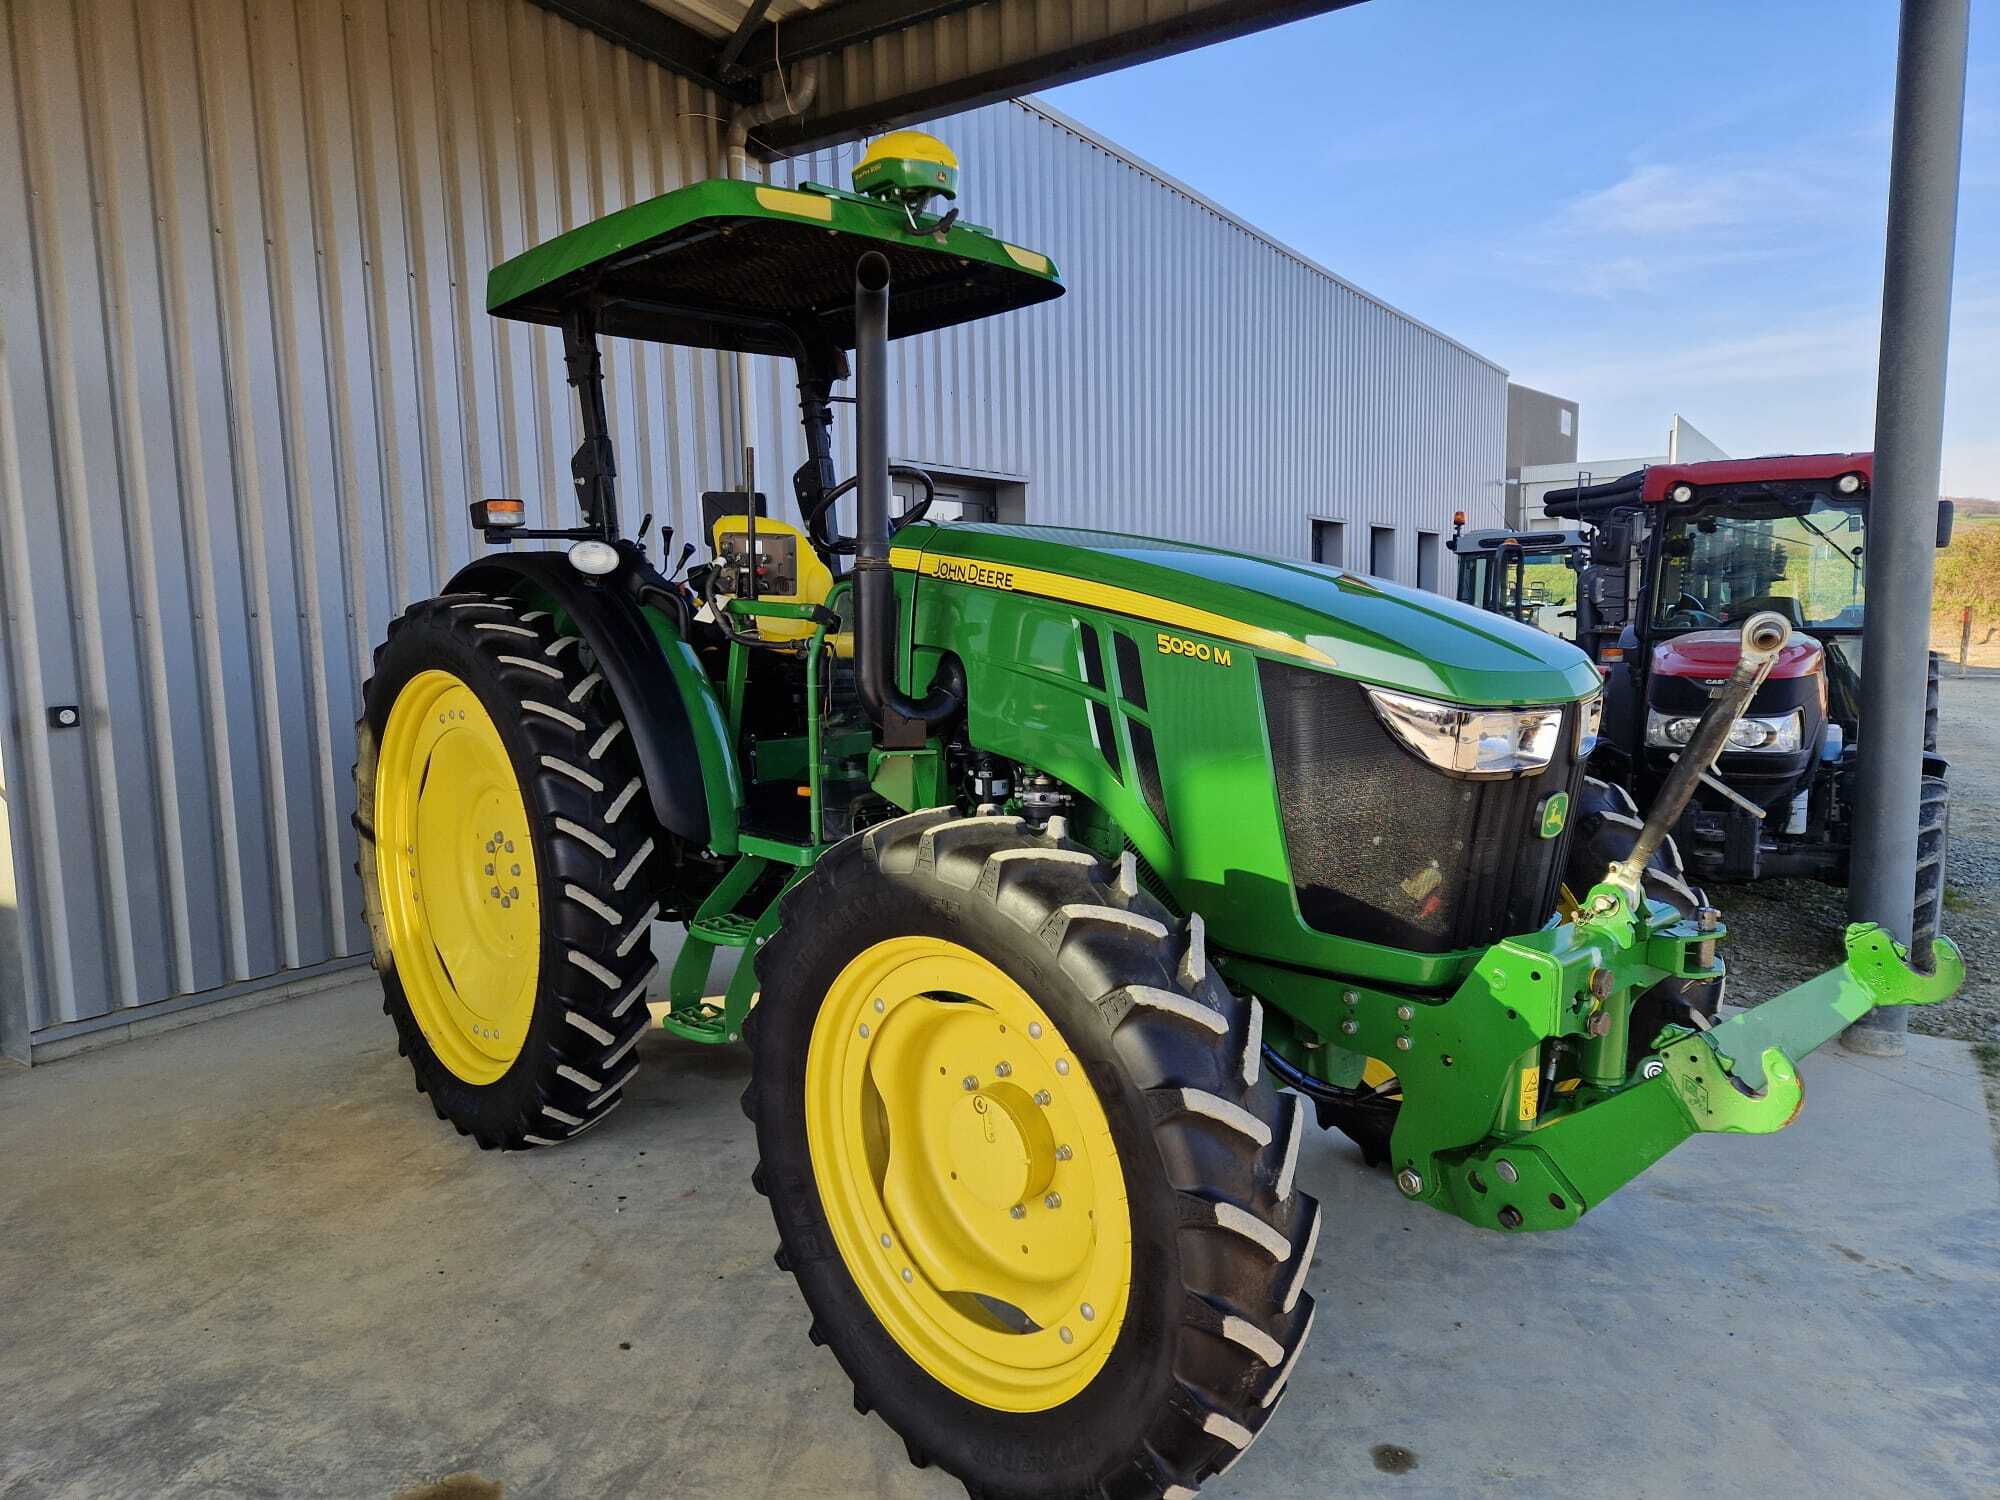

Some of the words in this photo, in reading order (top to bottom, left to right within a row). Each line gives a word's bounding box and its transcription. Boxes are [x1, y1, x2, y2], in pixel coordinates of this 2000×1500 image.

[933, 560, 967, 580] JOHN
[967, 564, 1014, 588] DEERE
[1157, 633, 1211, 662] 5090
[1213, 647, 1232, 667] M
